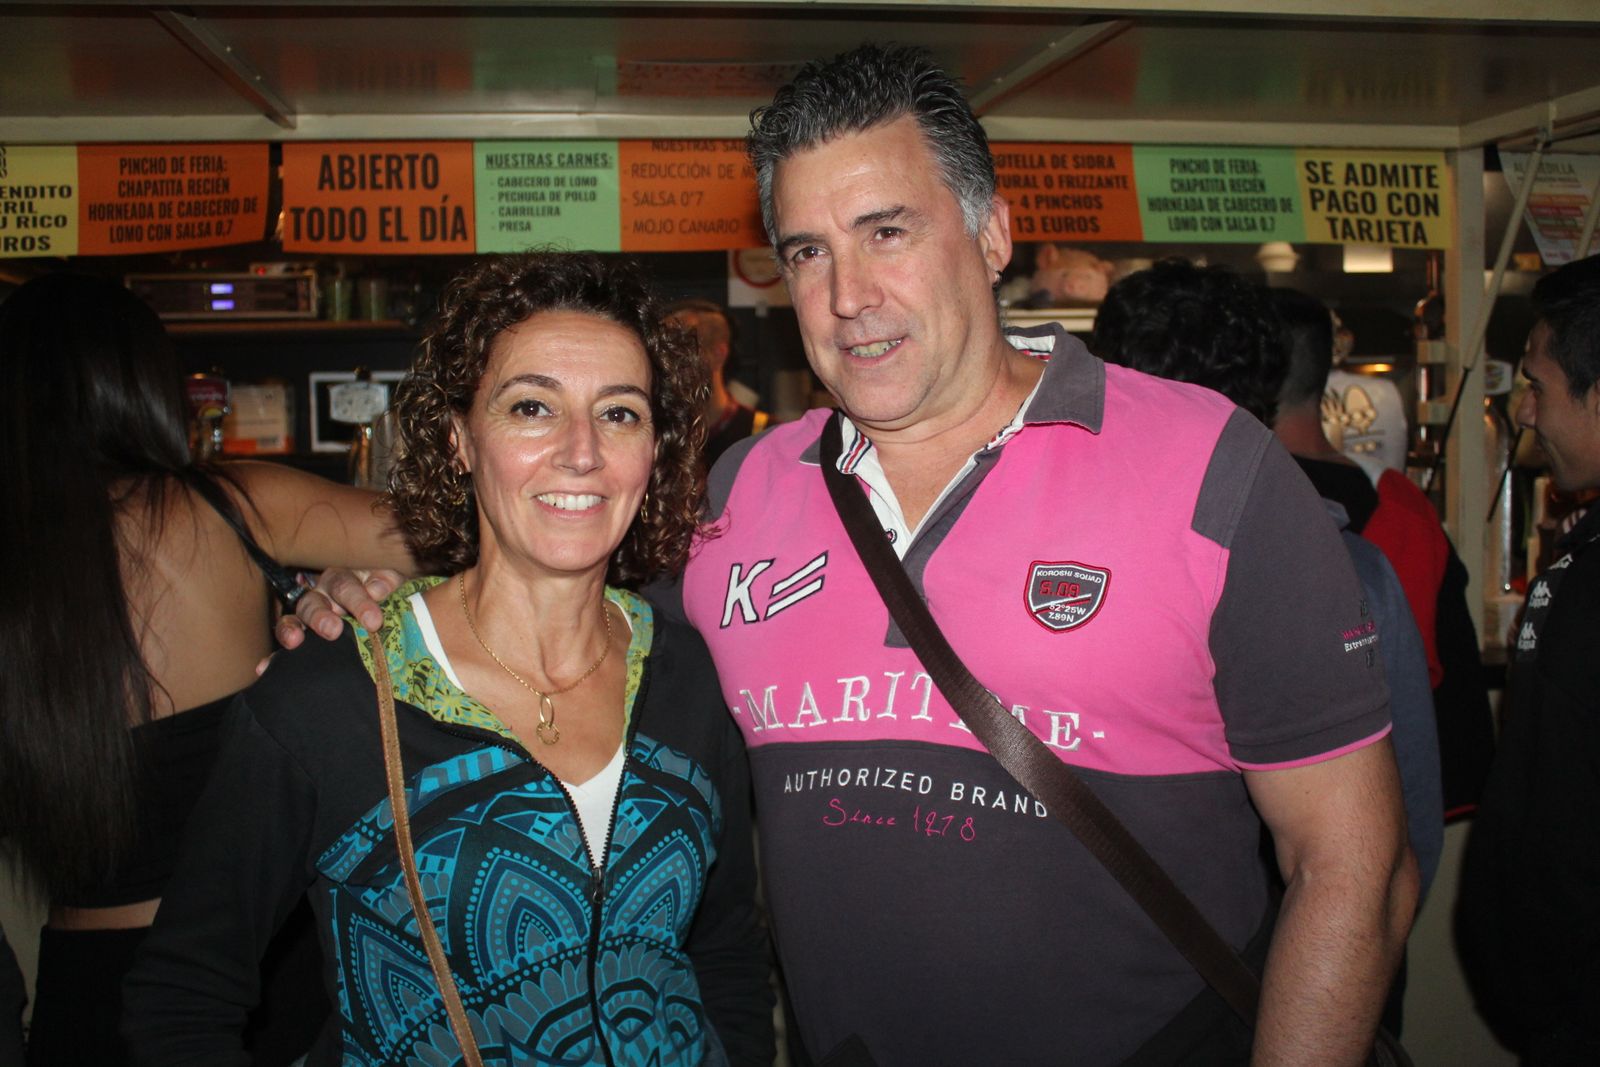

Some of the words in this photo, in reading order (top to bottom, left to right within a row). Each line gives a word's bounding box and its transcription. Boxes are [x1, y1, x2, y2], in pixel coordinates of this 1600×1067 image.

[651, 140, 716, 152] NUESTRAS
[119, 157, 167, 175] PINCHO
[170, 156, 185, 174] DE
[190, 155, 227, 173] FERIA:
[486, 153, 553, 168] NUESTRAS
[557, 153, 613, 168] CARNES:
[995, 154, 1047, 169] OTELLA
[1050, 154, 1068, 169] DE
[1072, 154, 1116, 169] SIDRA
[1169, 158, 1210, 174] PINCHO
[1212, 158, 1226, 174] DE
[318, 153, 440, 191] ABIERTO
[718, 163, 735, 179] DE
[1304, 160, 1334, 185] SE
[1344, 163, 1439, 189] ADMITE
[118, 179, 183, 198] CHAPATITA
[497, 176, 551, 187] CABECERO
[554, 176, 566, 187] DE
[569, 176, 597, 187] LOMO
[1043, 174, 1054, 189] O
[1058, 174, 1128, 189] FRIZZANTE
[1170, 178, 1227, 193] CHAPATITA
[498, 191, 545, 202] PECHUGA
[549, 190, 562, 202] DE
[564, 190, 597, 202] POLLO
[632, 190, 676, 207] SALSA
[1021, 194, 1030, 209] 4
[1035, 194, 1104, 210] PINCHOS
[1309, 188, 1377, 216] PAGO
[1387, 191, 1441, 217] CON
[0, 201, 37, 214] RIL
[88, 201, 154, 221] HORNEADA
[158, 200, 173, 219] DE
[177, 198, 240, 217] CABECERO
[243, 197, 257, 214] DE
[498, 205, 562, 217] CARRILLERA
[1147, 196, 1205, 212] HORNEADA
[1207, 197, 1220, 212] DE
[1223, 197, 1278, 212] CABECERO
[1280, 197, 1293, 213] DE
[16, 215, 67, 229] RICO
[290, 206, 367, 241] TODO
[379, 206, 409, 241] EL
[419, 194, 468, 241] DÍA
[632, 218, 674, 234] MOJO
[679, 217, 741, 234] CANARIO
[1015, 216, 1036, 233] 13
[1041, 215, 1101, 233] EUROS
[1168, 216, 1198, 232] LOMO
[1200, 216, 1223, 231] CON
[1225, 216, 1258, 231] SALSA
[109, 224, 143, 244] LOMO
[147, 223, 172, 241] CON
[175, 221, 211, 240] SALSA
[498, 221, 532, 232] PRESA
[1326, 216, 1428, 246] TARJETA
[0, 236, 51, 252] ROS
[1073, 572, 1102, 584] SQUAD
[784, 767, 932, 794] AUTHORIZED
[950, 782, 1048, 818] BRAND
[823, 798, 897, 827] Since
